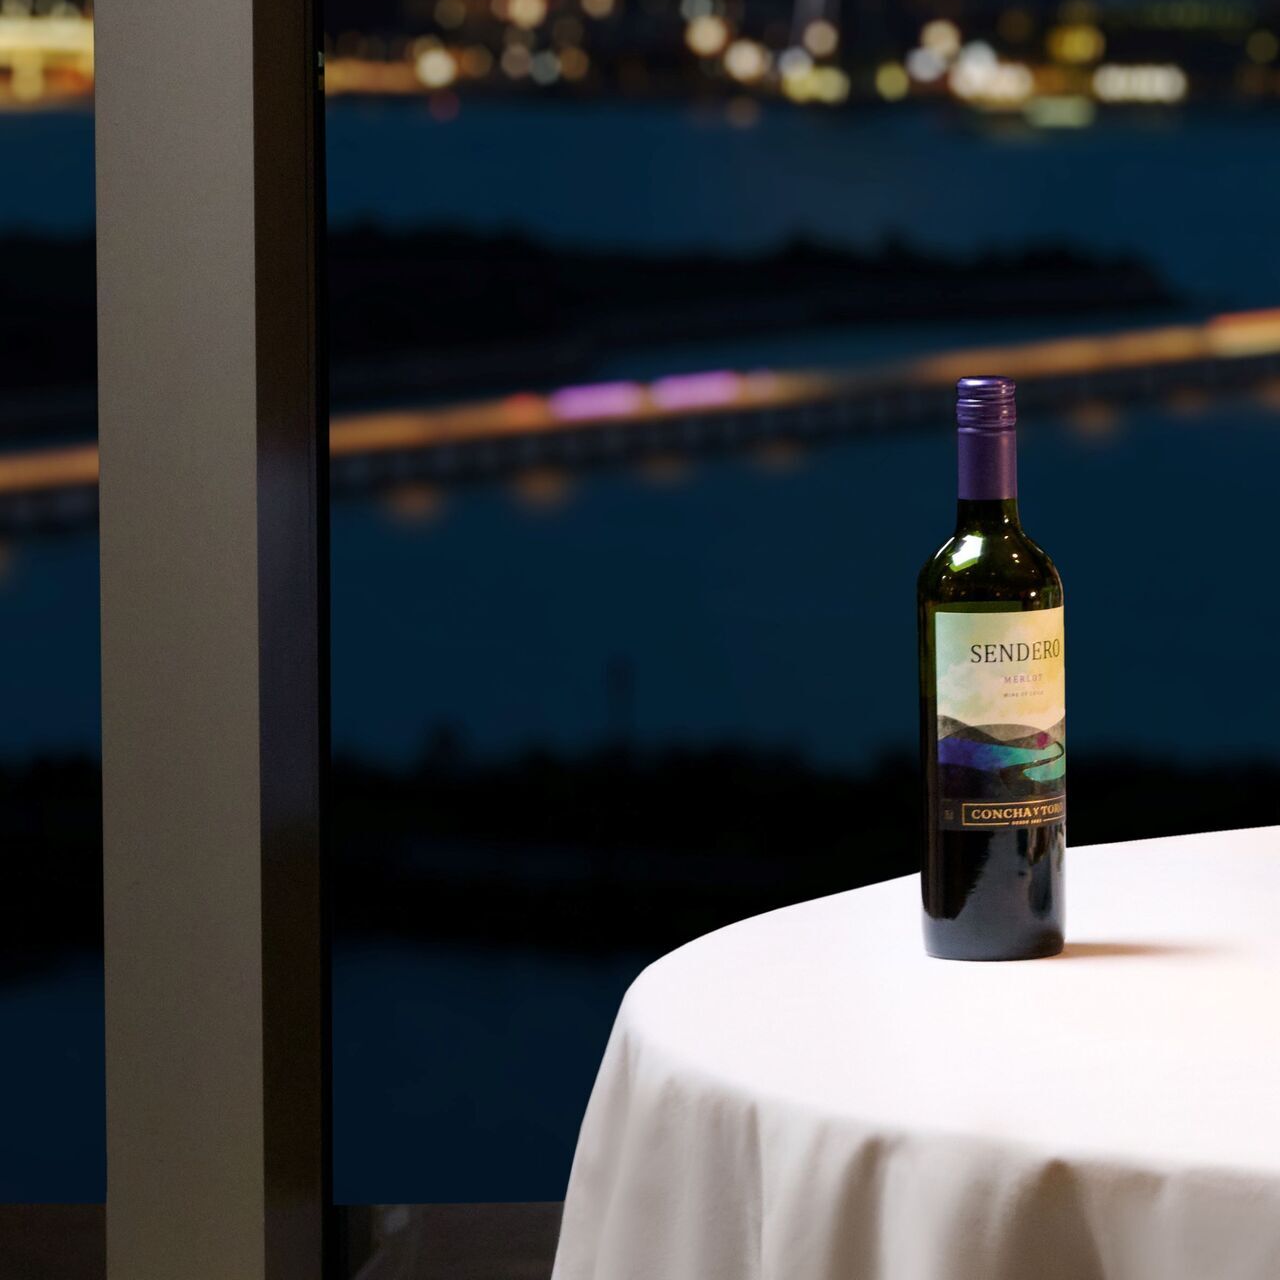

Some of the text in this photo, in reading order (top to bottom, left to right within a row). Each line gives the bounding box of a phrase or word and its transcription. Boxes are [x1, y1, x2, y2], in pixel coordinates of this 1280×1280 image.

[970, 638, 1060, 663] SENDERO
[1003, 673, 1043, 684] MERLOT
[971, 807, 1032, 820] CONCHA
[1033, 806, 1040, 816] Y
